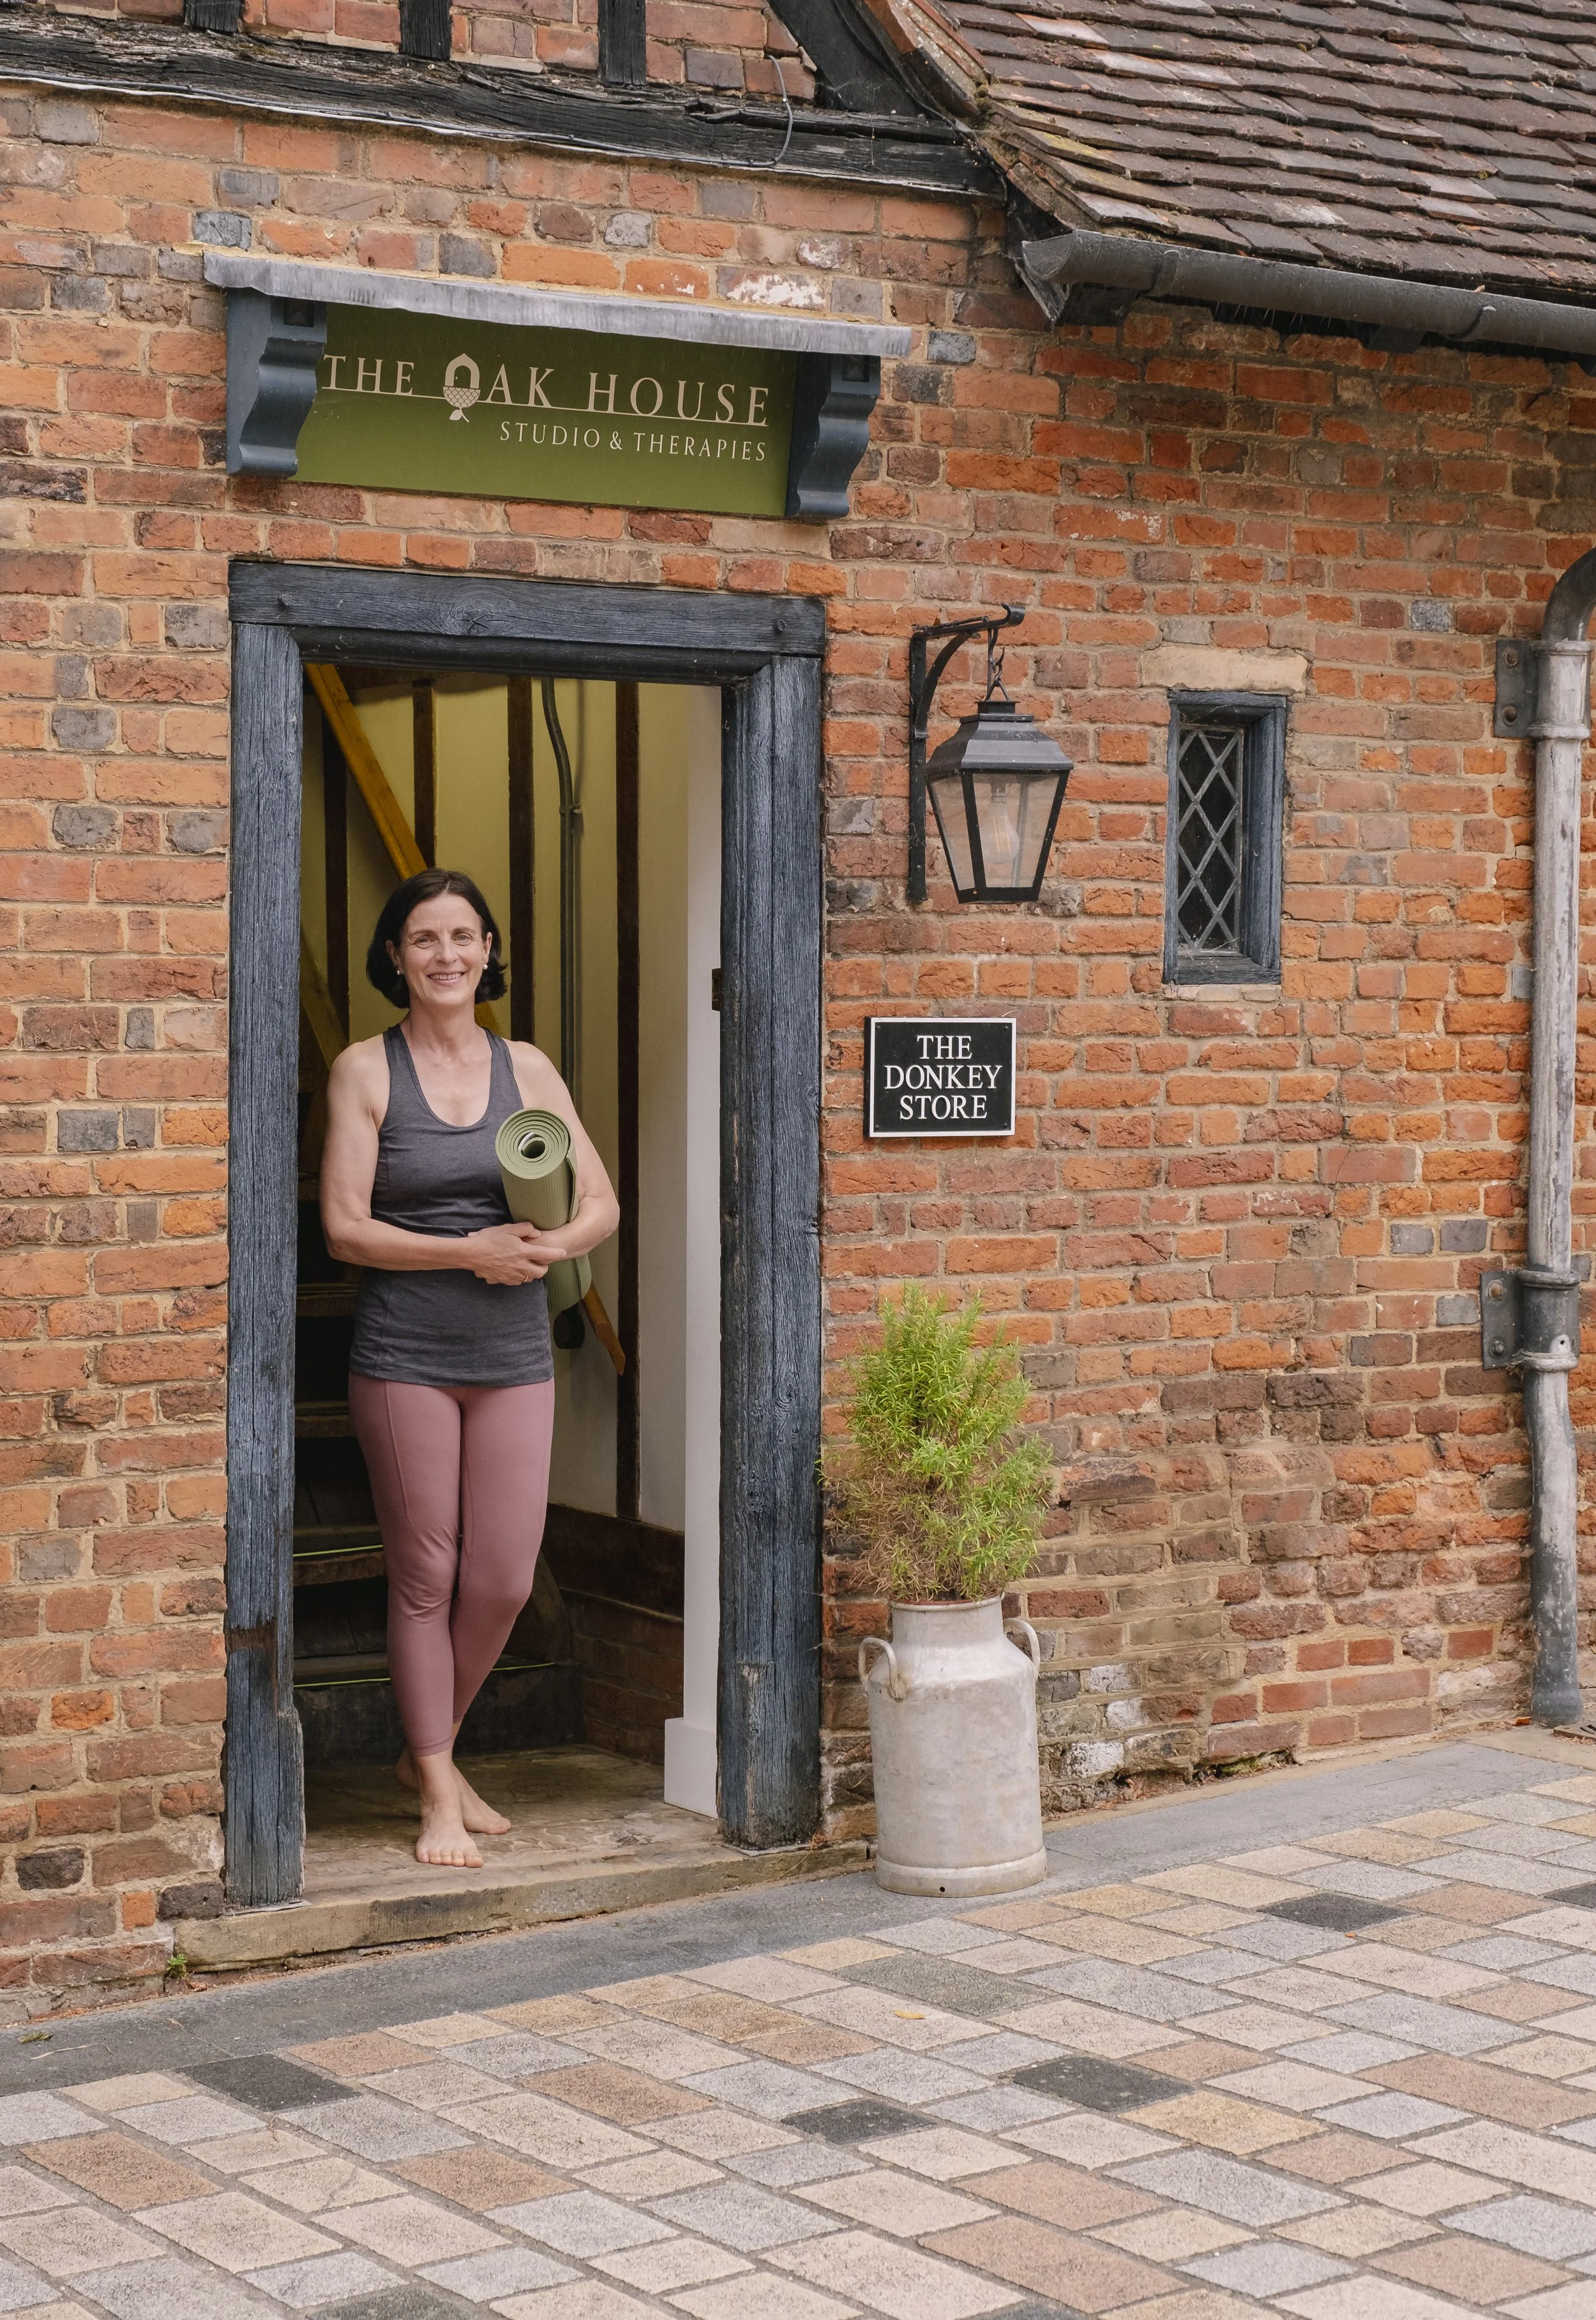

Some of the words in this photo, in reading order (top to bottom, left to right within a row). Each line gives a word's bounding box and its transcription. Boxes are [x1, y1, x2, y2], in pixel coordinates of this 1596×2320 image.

[322, 354, 414, 396] THE
[587, 372, 769, 426] HOUSE
[500, 421, 600, 448] STUDIO
[610, 431, 622, 450] &
[633, 432, 765, 462] THERAPIES
[917, 1035, 972, 1060] THE
[884, 1064, 1002, 1090] DONKEY
[900, 1095, 988, 1120] STORE
